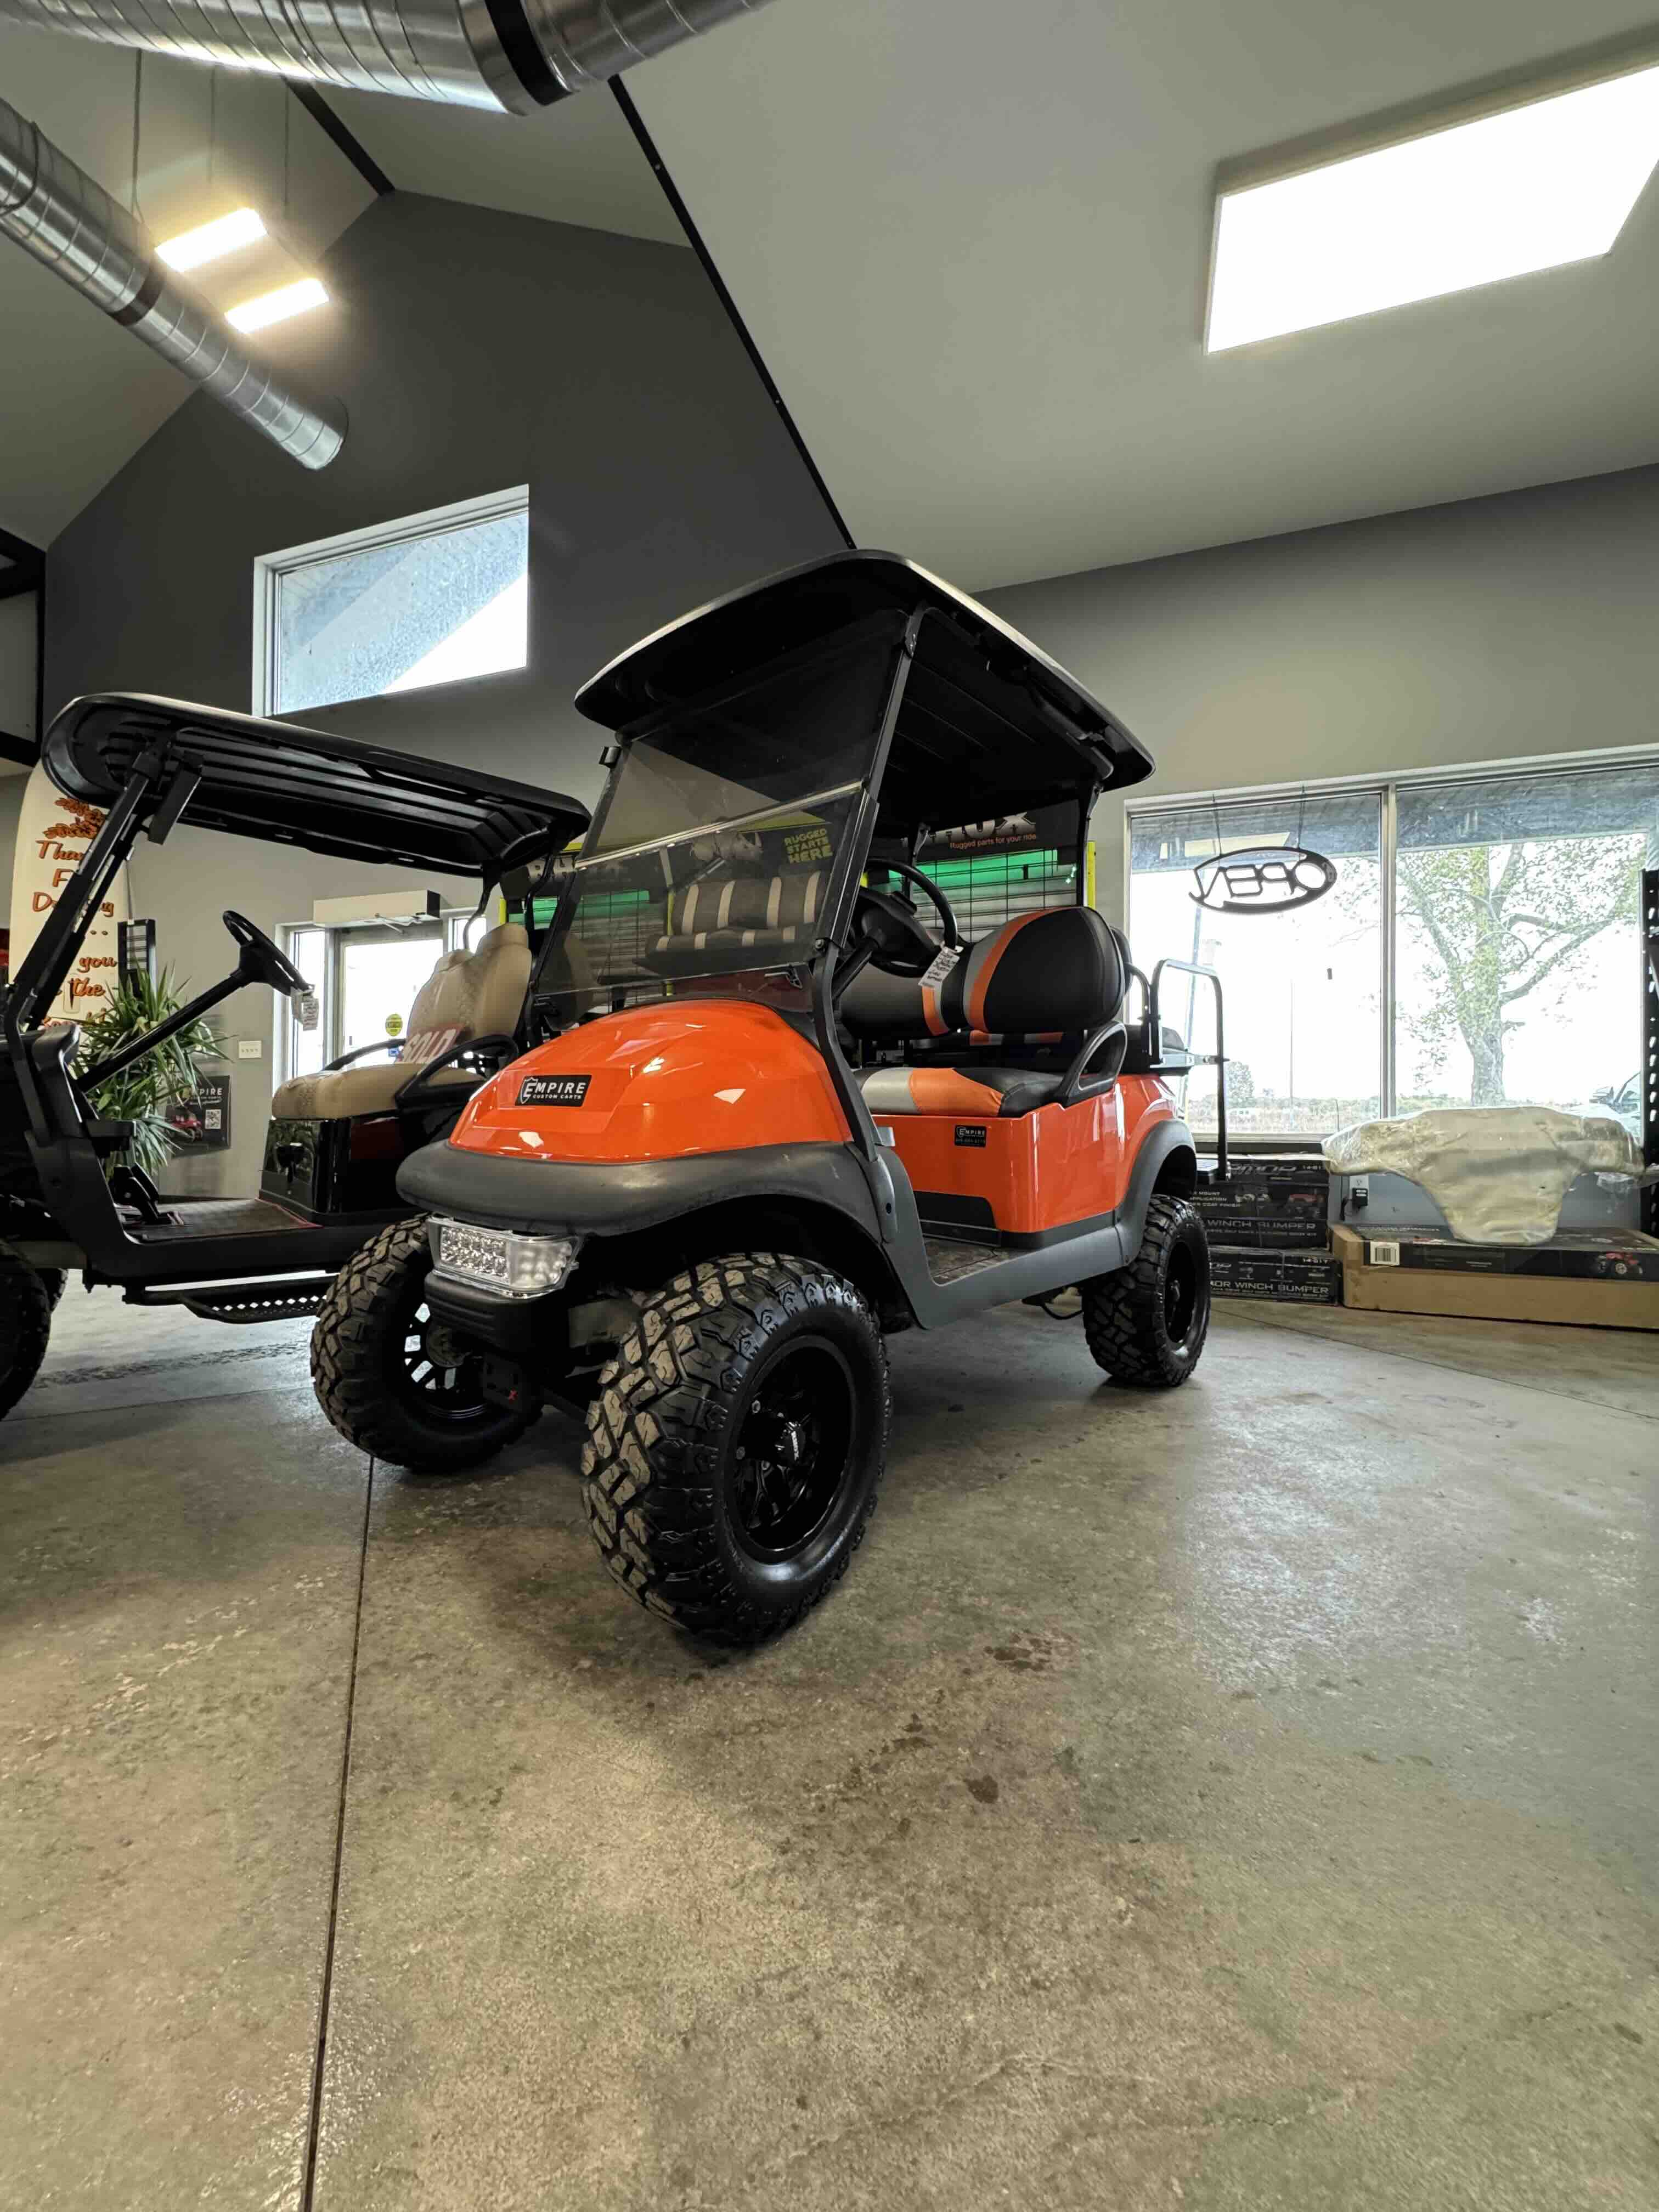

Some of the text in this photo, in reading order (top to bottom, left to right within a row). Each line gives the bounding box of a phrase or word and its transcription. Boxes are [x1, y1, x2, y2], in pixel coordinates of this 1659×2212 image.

[784, 829, 827, 846] RUGGED
[787, 837, 828, 854] STARTS
[950, 841, 975, 850] Rugged
[978, 838, 995, 847] parts
[1006, 836, 1021, 844] your
[788, 844, 833, 863] HERE
[77, 957, 117, 972] you
[71, 977, 105, 996] the
[403, 1029, 456, 1062] SOLD
[523, 1082, 586, 1097] EMPIRE
[1207, 1220, 1316, 1230] WINCH BUMPER
[1234, 1282, 1273, 1290] WINCH
[1278, 1284, 1329, 1294] BUMPER
